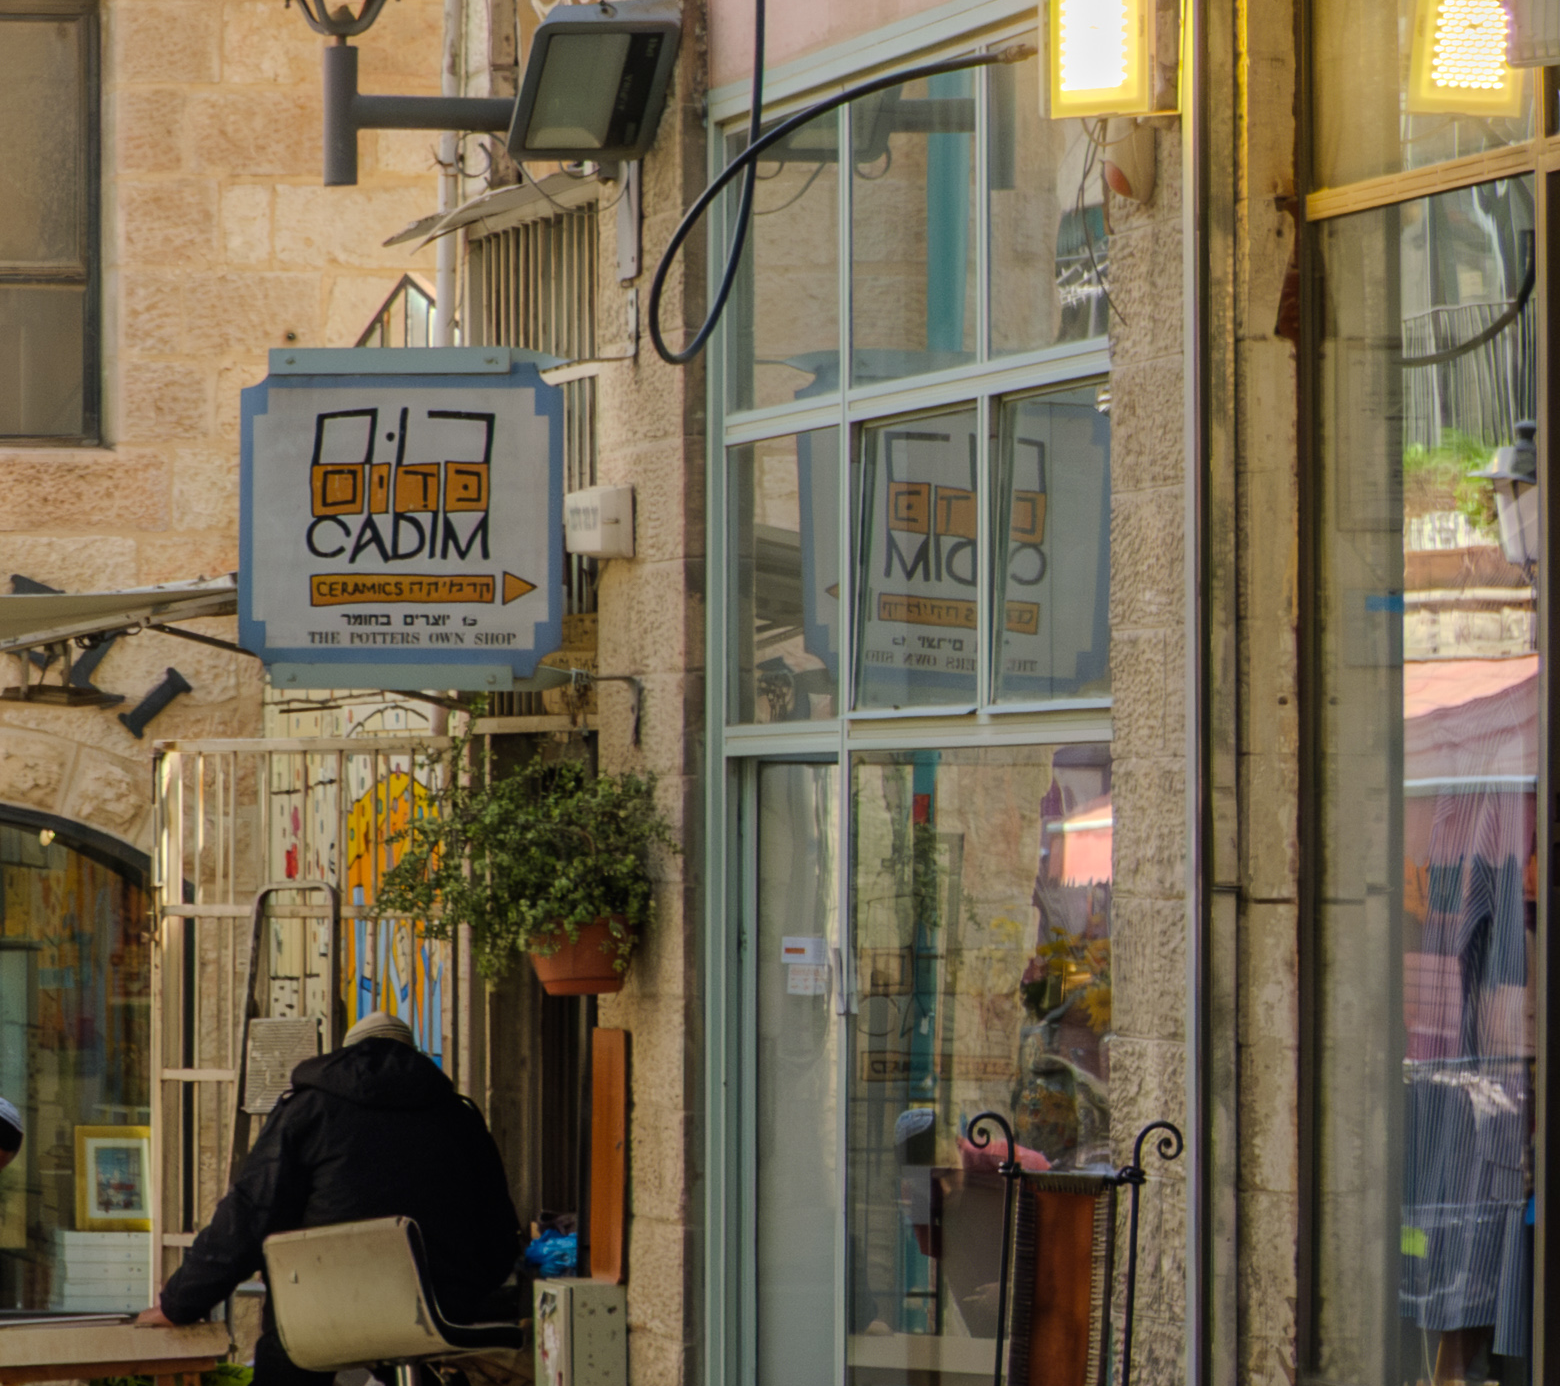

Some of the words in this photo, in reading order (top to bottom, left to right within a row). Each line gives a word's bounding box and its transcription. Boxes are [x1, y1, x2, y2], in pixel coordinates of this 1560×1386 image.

[306, 512, 490, 564] CADIM
[316, 581, 404, 597] CERAMICS
[340, 614, 392, 627] בחומר
[403, 614, 451, 627] יוצרים
[308, 631, 341, 644] THE
[350, 632, 420, 645] POTTERS
[429, 633, 465, 645] OWN
[474, 633, 517, 646] SHOP
